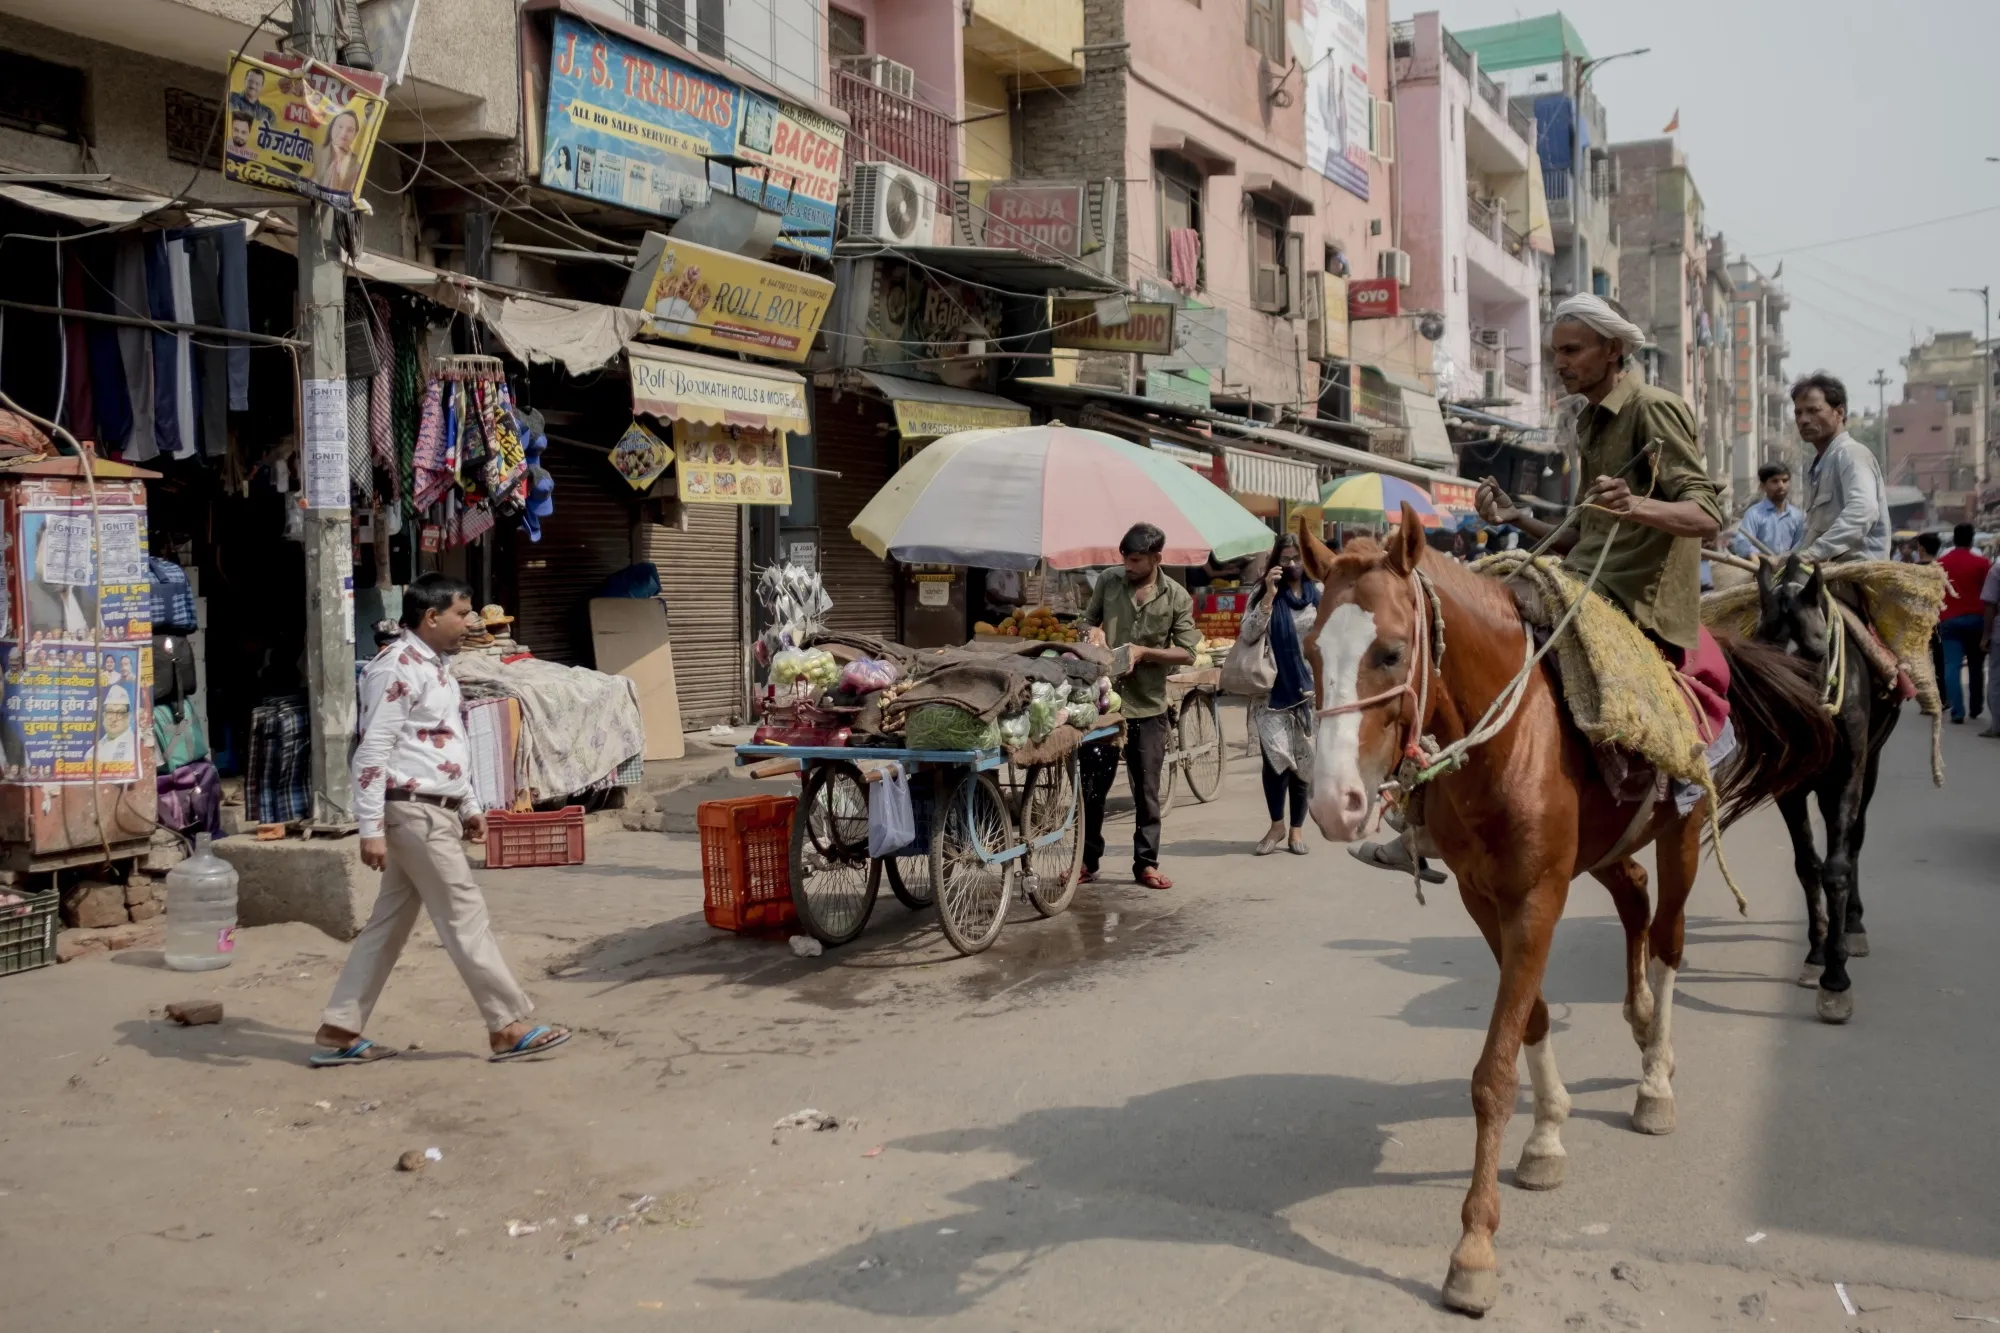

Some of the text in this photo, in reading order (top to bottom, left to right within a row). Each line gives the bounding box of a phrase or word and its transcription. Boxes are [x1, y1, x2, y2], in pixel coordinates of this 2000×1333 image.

[558, 32, 733, 128] J. S. TRADERS
[572, 105, 590, 121] ALL
[593, 111, 608, 126] RO
[611, 115, 638, 135] SALES
[641, 126, 678, 147] SERVICE
[681, 139, 688, 150] &
[774, 121, 840, 174] BAGGA
[1001, 198, 1065, 220] RAJA
[992, 223, 1073, 246] STUDIO
[711, 282, 761, 321] ROLL
[764, 294, 808, 331] BOX
[1057, 310, 1097, 338] RAJA
[310, 387, 343, 397] IGNITE
[632, 364, 666, 396] Roll
[732, 386, 758, 403] ROLLS
[759, 391, 765, 403] &
[767, 392, 790, 407] MORE
[53, 523, 88, 535] IGNITE
[103, 522, 135, 531] IGNITE
[7, 696, 21, 711] श्री
